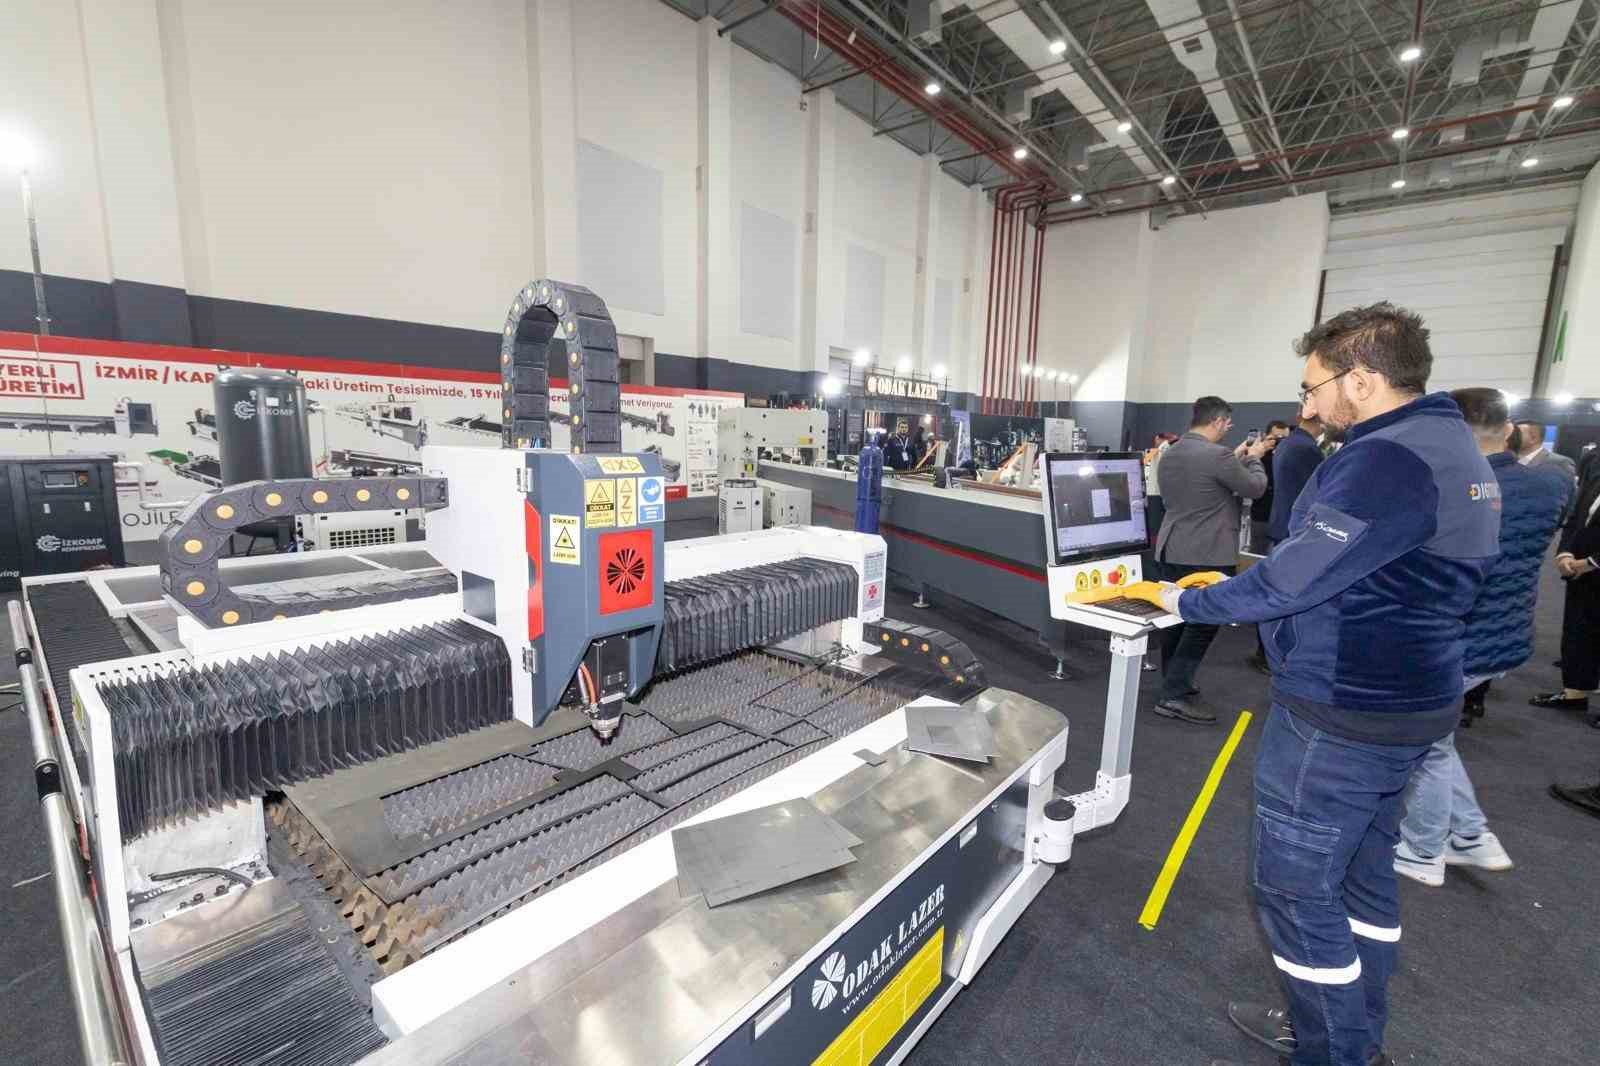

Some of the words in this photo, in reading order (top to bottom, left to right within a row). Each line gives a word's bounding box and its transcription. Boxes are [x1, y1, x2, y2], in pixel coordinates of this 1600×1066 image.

[95, 361, 158, 380] İZMİR
[333, 376, 384, 393] Üretim
[878, 376, 905, 396] ODAK
[907, 381, 938, 400] LAZER
[841, 906, 945, 1014] www.odaklazer.com.tr
[842, 934, 893, 998] ODAK
[898, 884, 945, 945] LAZER
